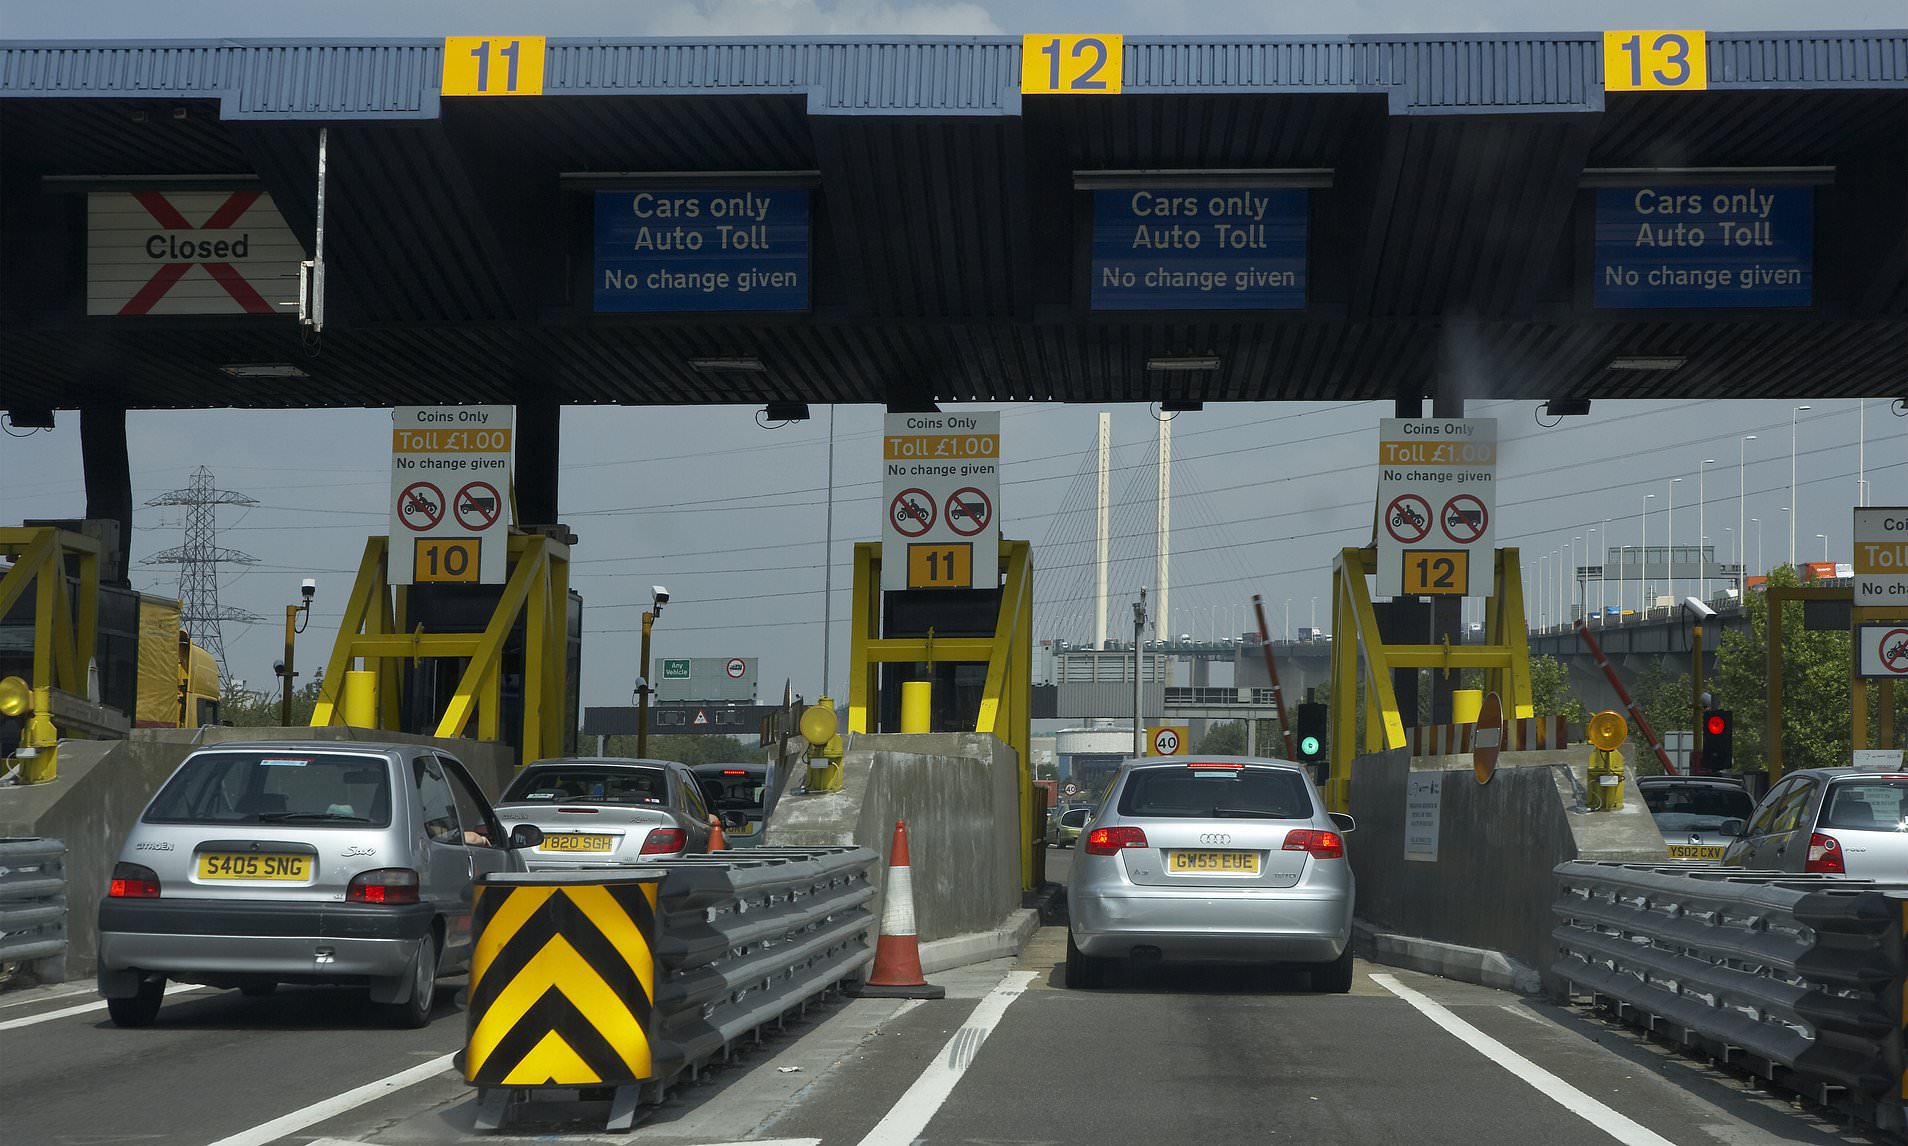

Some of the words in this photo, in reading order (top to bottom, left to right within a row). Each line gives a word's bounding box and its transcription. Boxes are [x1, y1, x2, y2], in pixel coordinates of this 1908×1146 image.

[471, 41, 519, 92] 11
[1041, 38, 1108, 90] 12
[1621, 34, 1691, 86] 13
[633, 193, 700, 218] Cars
[710, 192, 770, 221] only
[1131, 192, 1199, 217] Cars
[1208, 191, 1269, 220] only
[1635, 189, 1702, 214] Cars
[1712, 188, 1774, 217] only
[634, 226, 703, 251] Auto
[717, 225, 768, 250] Toll
[1132, 225, 1202, 250] Auto
[1215, 224, 1267, 249] Toll
[1636, 223, 1705, 247] Auto
[1719, 221, 1773, 246] Toll
[145, 234, 249, 259] Closed
[605, 270, 638, 289] No
[646, 269, 730, 292] change
[738, 268, 797, 291] given
[1103, 269, 1137, 288] No
[1144, 268, 1229, 291] change
[1236, 267, 1296, 290] given
[1606, 266, 1640, 286] No
[1648, 265, 1732, 289] change
[1740, 265, 1801, 289] given
[417, 411, 454, 423] Coins
[457, 410, 488, 425] Only
[906, 417, 944, 429] Coins
[947, 417, 977, 432] Only
[1403, 423, 1440, 435] Coins
[1444, 422, 1474, 437] Only
[399, 430, 438, 450] Toll
[444, 431, 505, 450] £1.00
[889, 437, 928, 456] Toll
[934, 437, 994, 457] £1.00
[1385, 444, 1424, 463] Toll
[1430, 444, 1491, 463] £1.00
[396, 458, 414, 469] No
[420, 457, 466, 472] change
[469, 457, 506, 472] given
[888, 464, 906, 475] No
[910, 463, 956, 478] change
[960, 463, 995, 478] given
[1384, 470, 1401, 481] No
[1406, 469, 1453, 483] change
[1455, 469, 1492, 484] given
[1884, 518, 1908, 531] Coi
[425, 545, 469, 576] 10
[926, 551, 955, 581] 11
[1416, 557, 1455, 588] 12
[1862, 583, 1883, 595] No
[671, 662, 684, 670] Any
[1157, 737, 1177, 749] 40
[1066, 785, 1076, 793] 40
[543, 837, 579, 849] T820
[583, 837, 612, 849] SGH
[1670, 847, 1698, 858] YS02
[1700, 847, 1722, 859] CXV
[208, 856, 258, 875] S405
[263, 857, 304, 876] SNG
[1176, 854, 1218, 869] GW55
[1221, 854, 1254, 869] EUE
